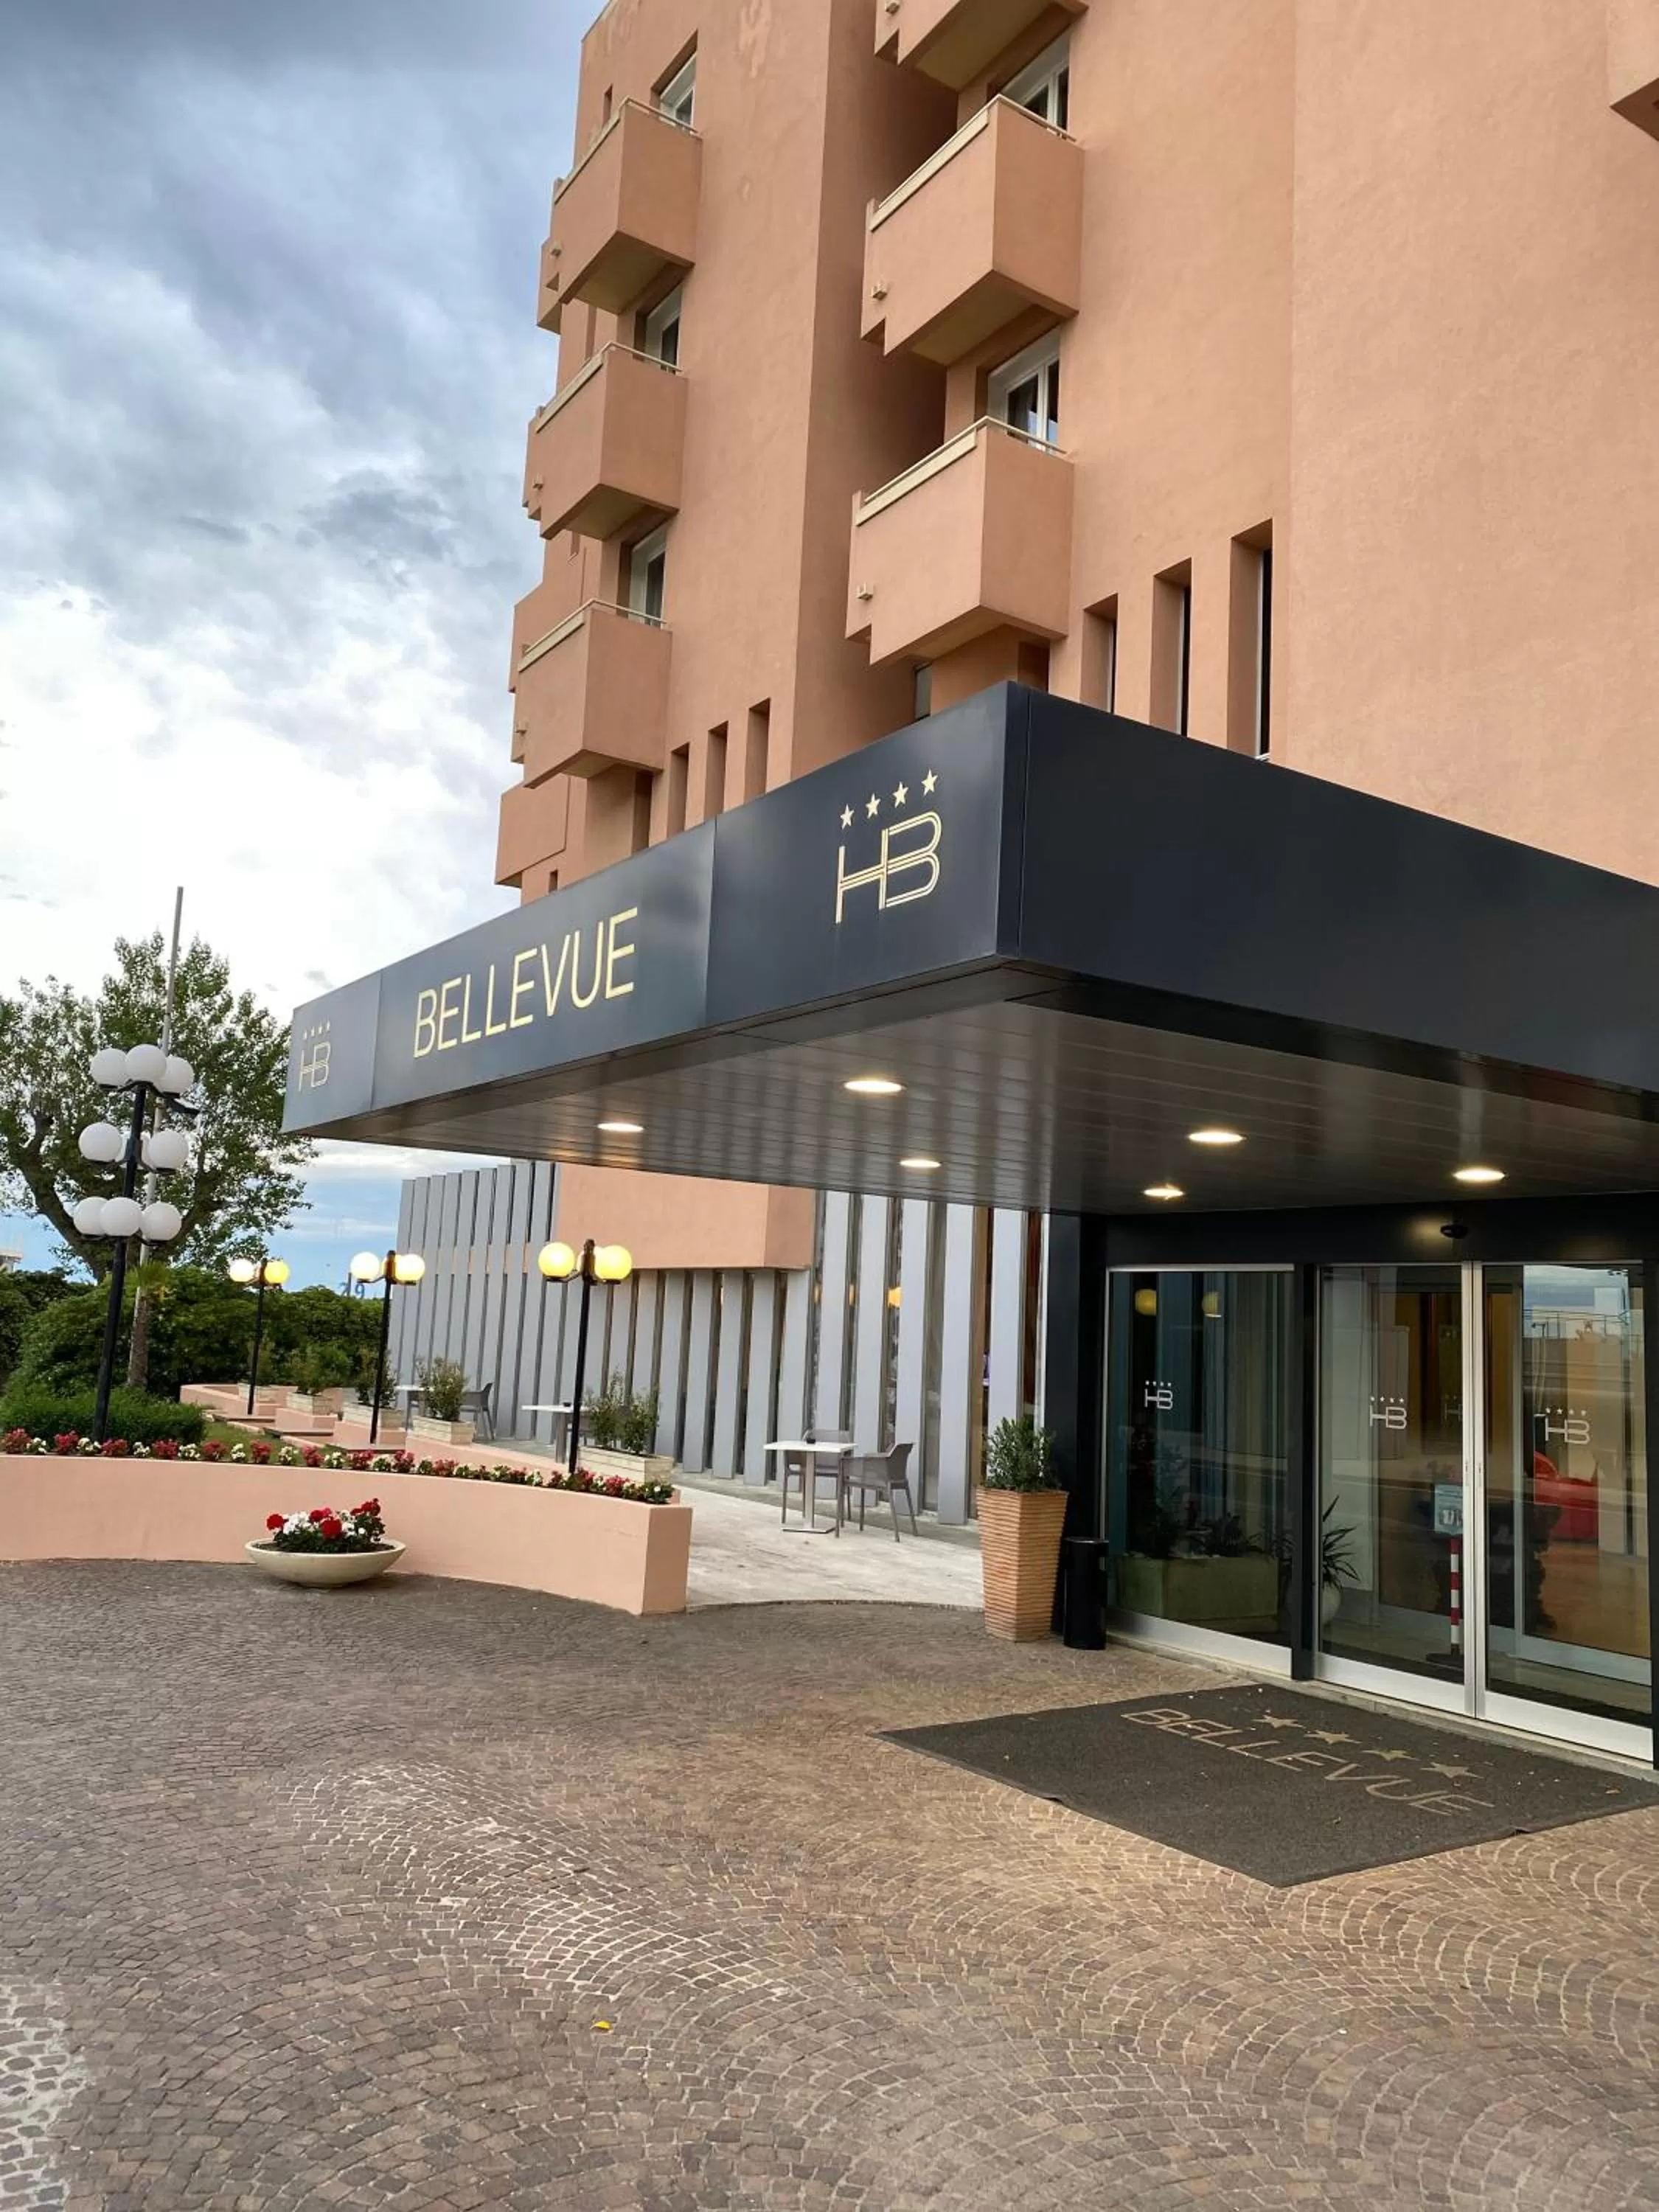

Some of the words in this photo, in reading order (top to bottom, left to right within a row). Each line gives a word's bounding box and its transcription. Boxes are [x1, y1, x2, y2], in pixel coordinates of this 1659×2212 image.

[834, 810, 942, 925] HB
[413, 906, 639, 1058] BELLEVUE
[298, 1041, 331, 1092] HB
[1144, 1388, 1173, 1410] HB
[1369, 1405, 1407, 1430] HB
[1545, 1417, 1590, 1444] HB
[1121, 1708, 1495, 1816] BELLEVUE
